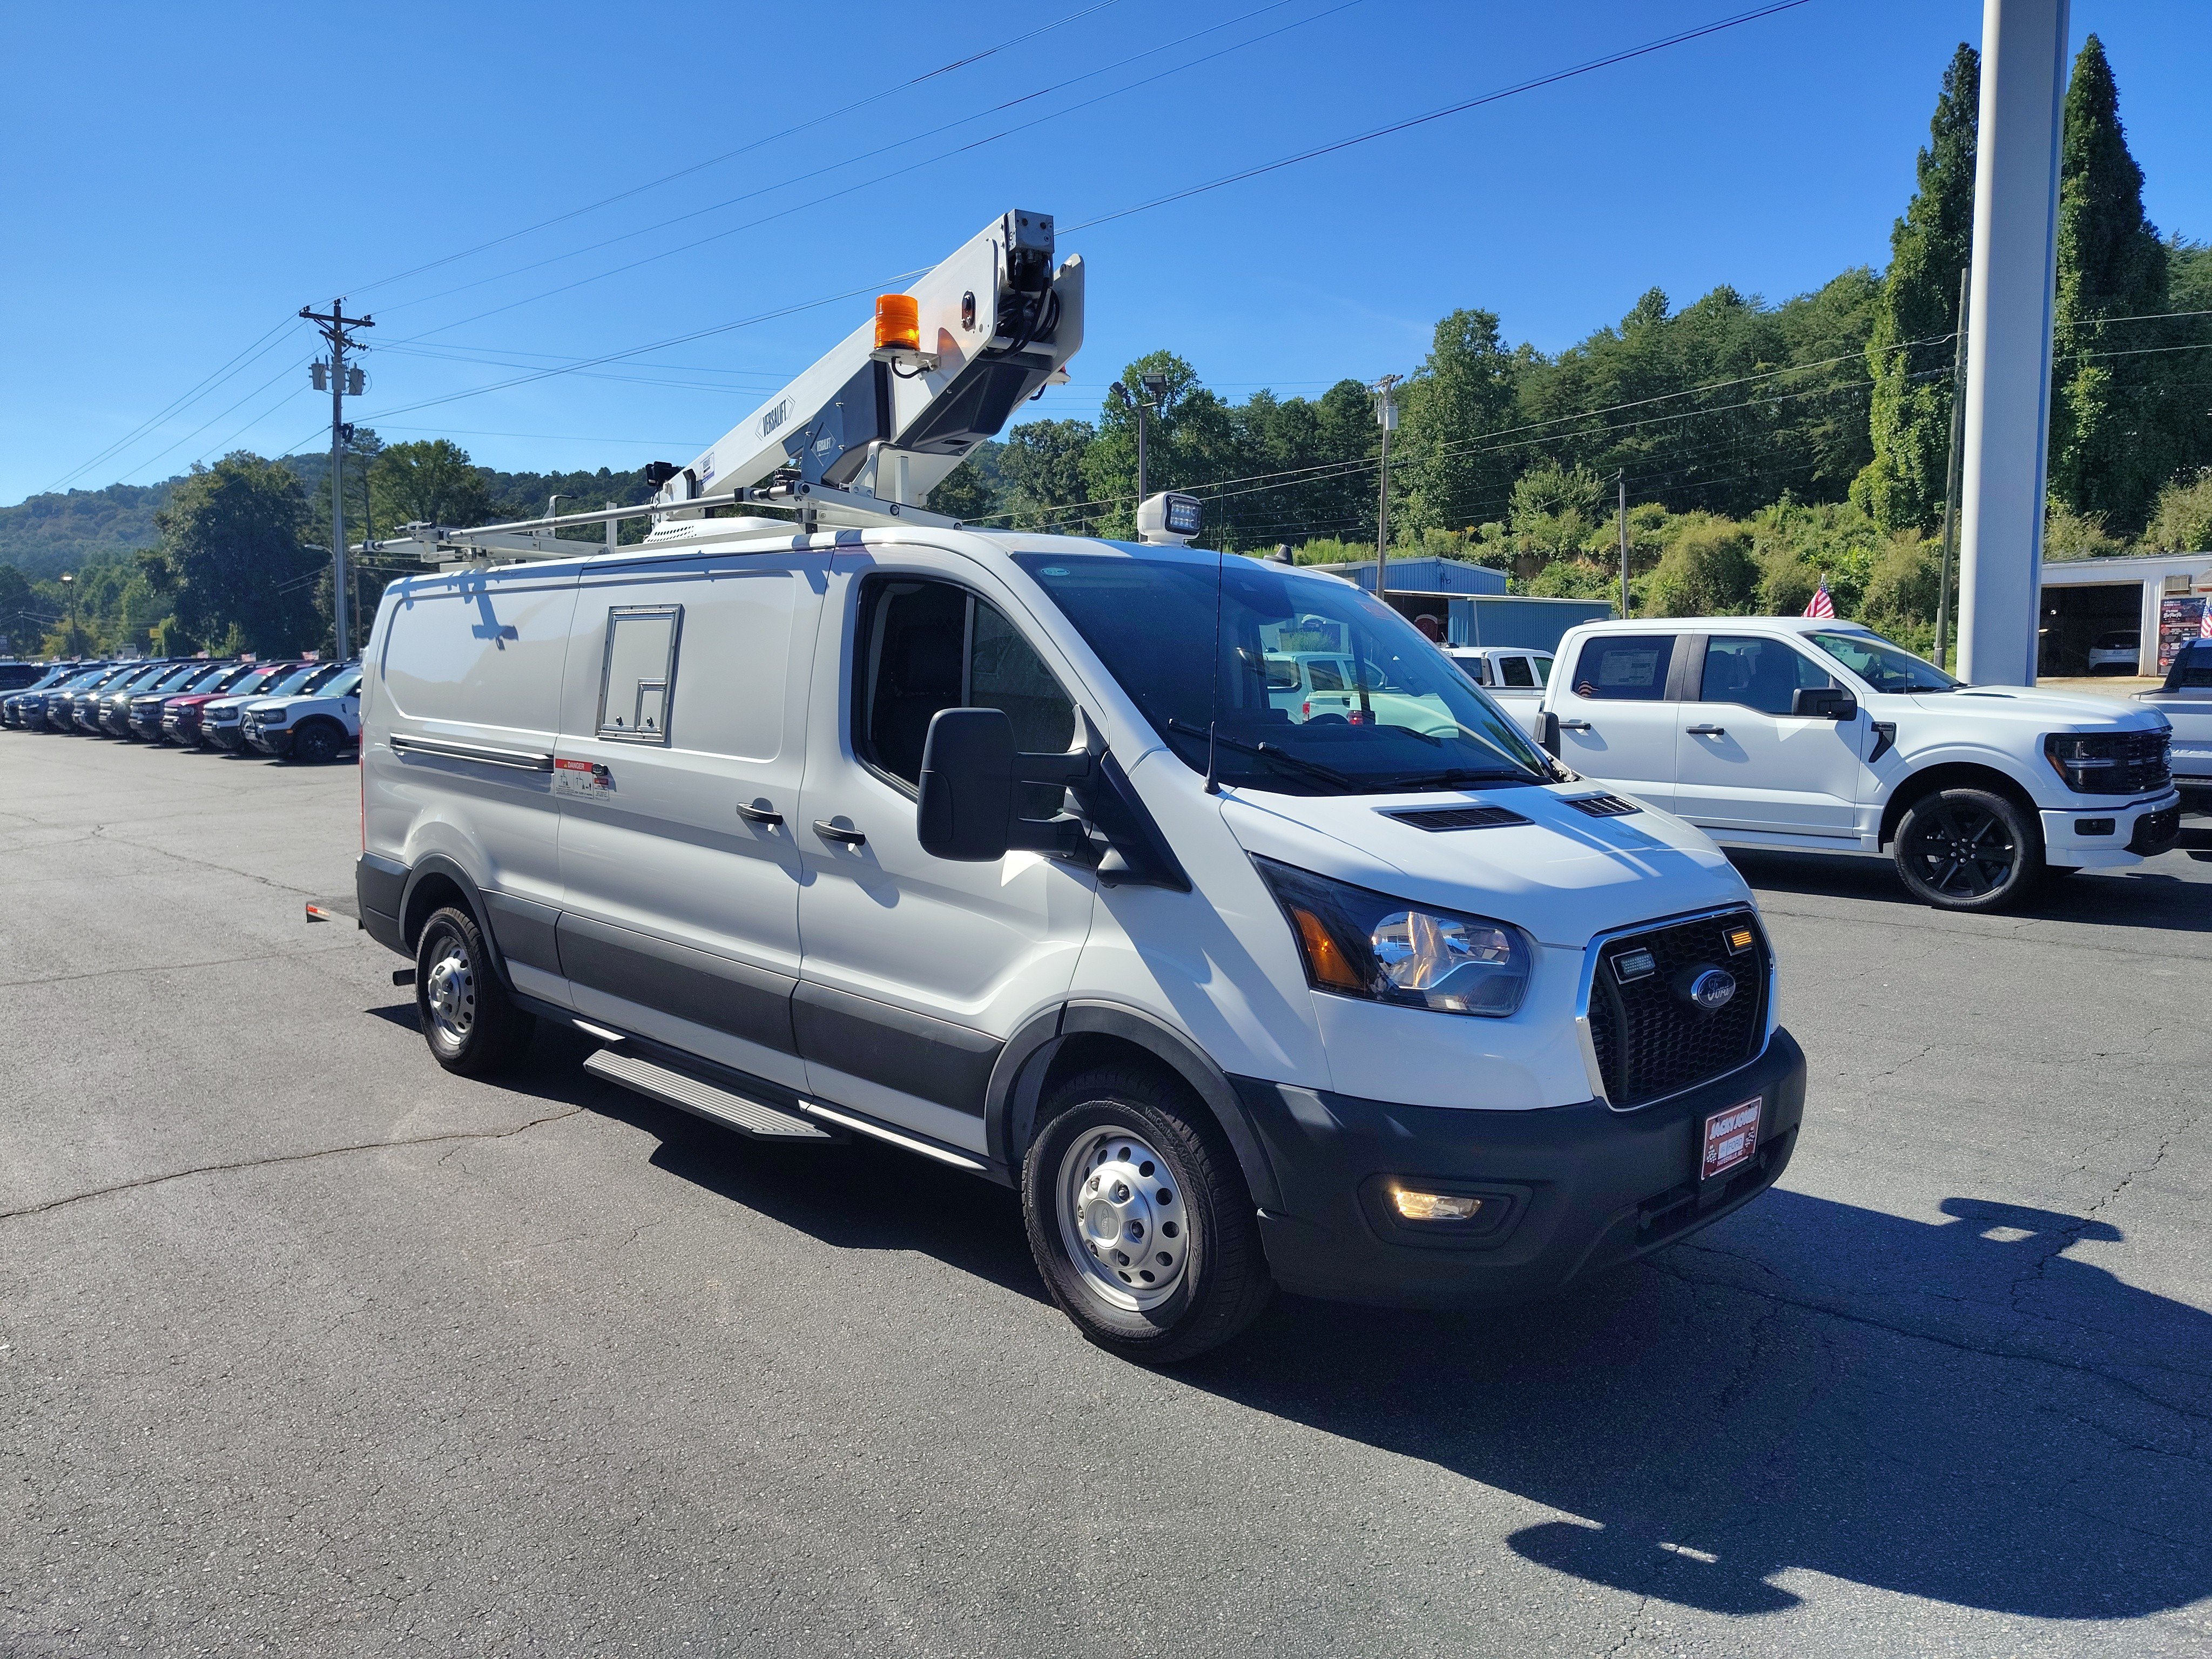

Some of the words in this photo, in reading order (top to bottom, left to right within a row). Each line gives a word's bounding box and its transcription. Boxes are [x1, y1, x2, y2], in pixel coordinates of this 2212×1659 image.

[763, 399, 786, 437] VERSALIFT
[817, 437, 831, 452] VERSALIFT
[568, 761, 584, 770] DANGER
[1708, 975, 1730, 1001] Ford
[1145, 1107, 1179, 1146] VanContact
[1709, 1115, 1736, 1141] JACKY
[1734, 1105, 1759, 1130] JONES
[1728, 1138, 1743, 1151] FORD
